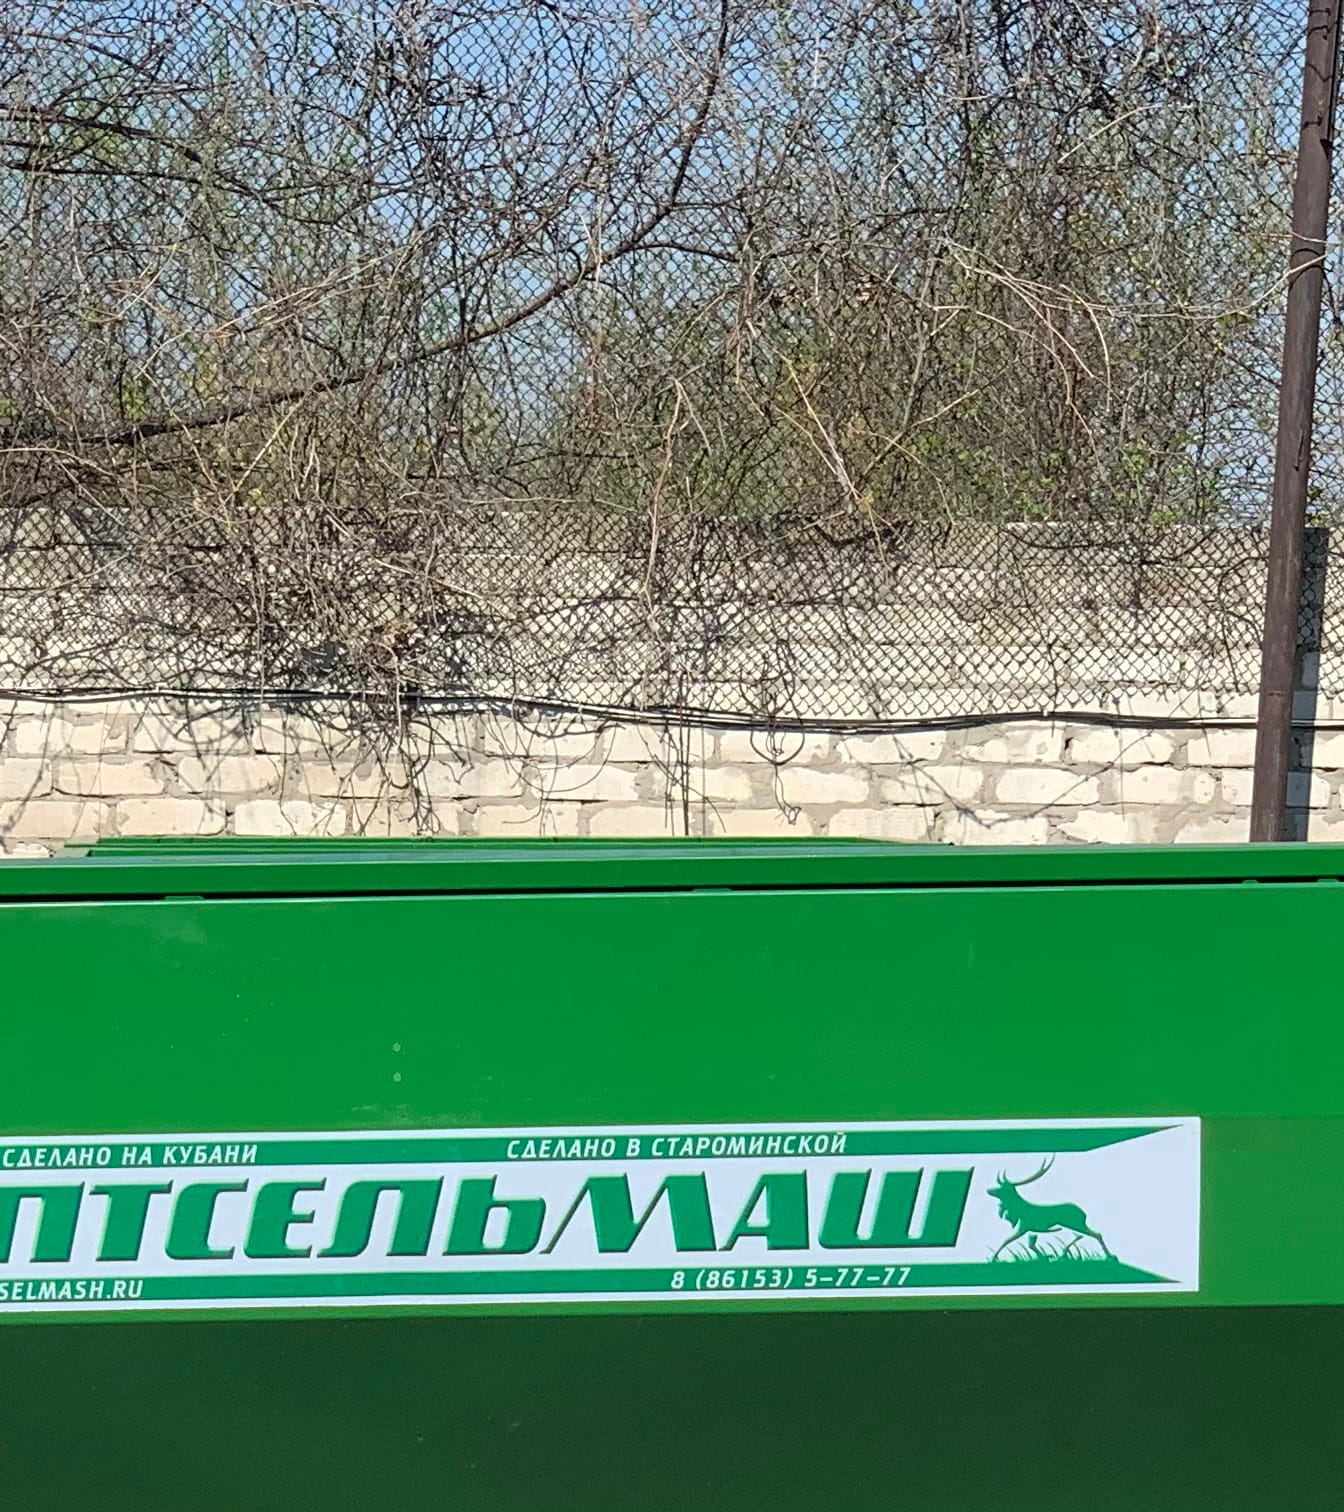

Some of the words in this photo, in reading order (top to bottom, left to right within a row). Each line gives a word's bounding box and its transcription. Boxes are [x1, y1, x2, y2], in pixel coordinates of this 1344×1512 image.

[1, 1146, 113, 1169] СДЕЛАНО
[121, 1146, 154, 1167] НА
[163, 1144, 258, 1166] КУБАНИ
[506, 1138, 617, 1160] СДЕЛАНО
[625, 1138, 642, 1158] В
[651, 1132, 847, 1157] СТАРОМИНСКОЙ
[671, 1272, 685, 1290] 8
[694, 1270, 794, 1291] (86153)
[804, 1267, 912, 1288] 5-77-77
